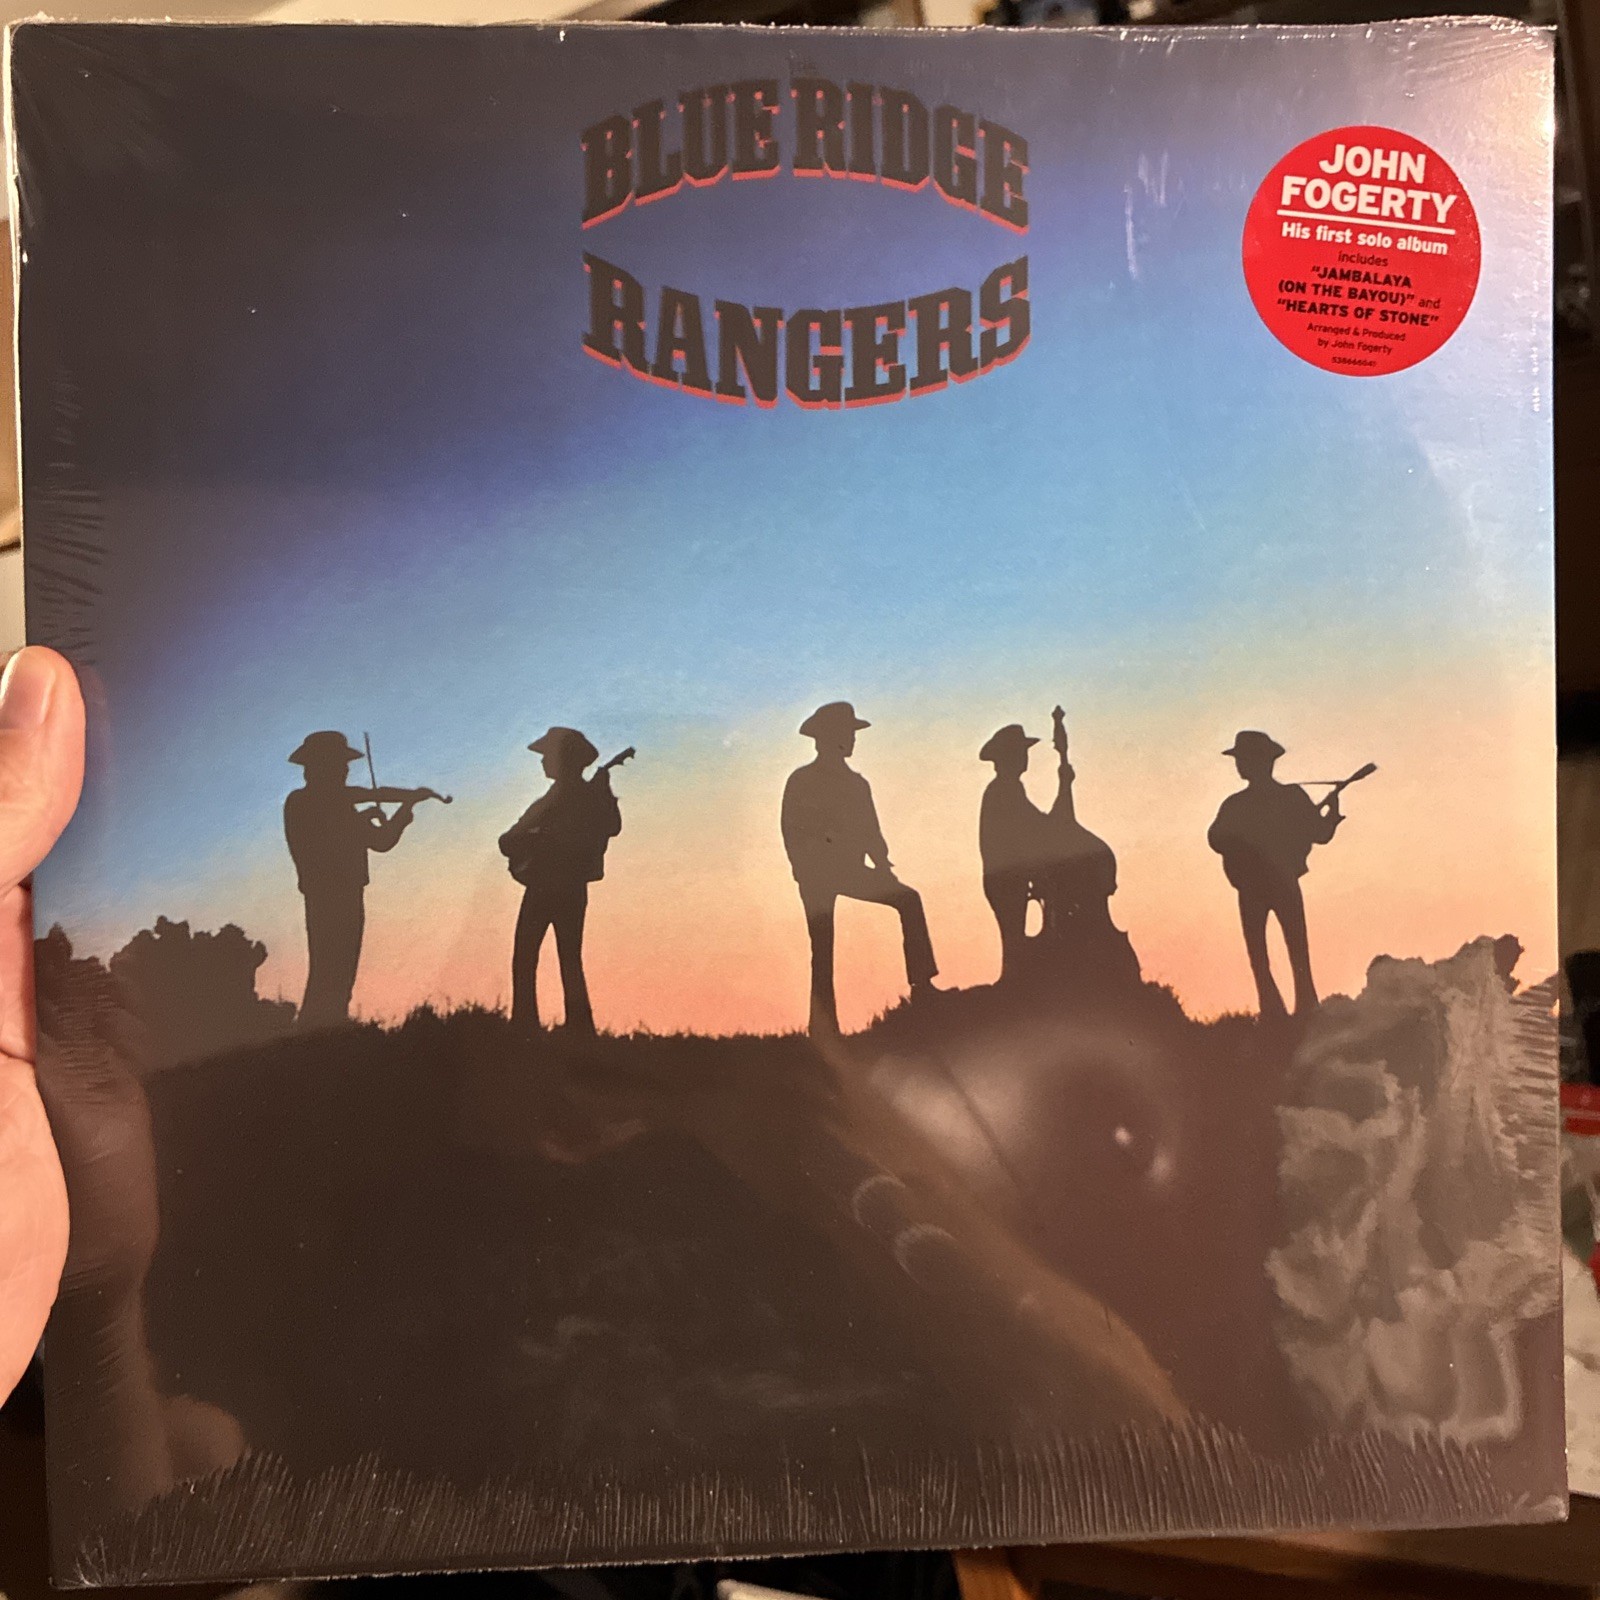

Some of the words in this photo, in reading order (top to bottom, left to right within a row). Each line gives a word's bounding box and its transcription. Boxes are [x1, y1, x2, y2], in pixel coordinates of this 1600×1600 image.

[581, 78, 781, 231] BLUE
[791, 77, 1030, 235] RIDGE
[1319, 144, 1426, 184] JOHN
[1281, 175, 1457, 223] FOGERTY
[1282, 222, 1311, 239] His
[1316, 226, 1353, 244] first
[1357, 232, 1392, 249] solo
[1397, 236, 1449, 256] album
[1337, 251, 1388, 267] includes
[1278, 279, 1306, 294] (ON
[1312, 283, 1342, 298] THE
[1418, 298, 1441, 309] and
[1354, 306, 1375, 320] OF
[581, 250, 1031, 410] RANGERS
[1307, 323, 1351, 336] Arranged
[1352, 327, 1360, 336] &
[1362, 328, 1406, 342] Produced
[1317, 338, 1329, 349] by
[1331, 341, 1355, 350] John
[1357, 342, 1393, 355] Fogerty
